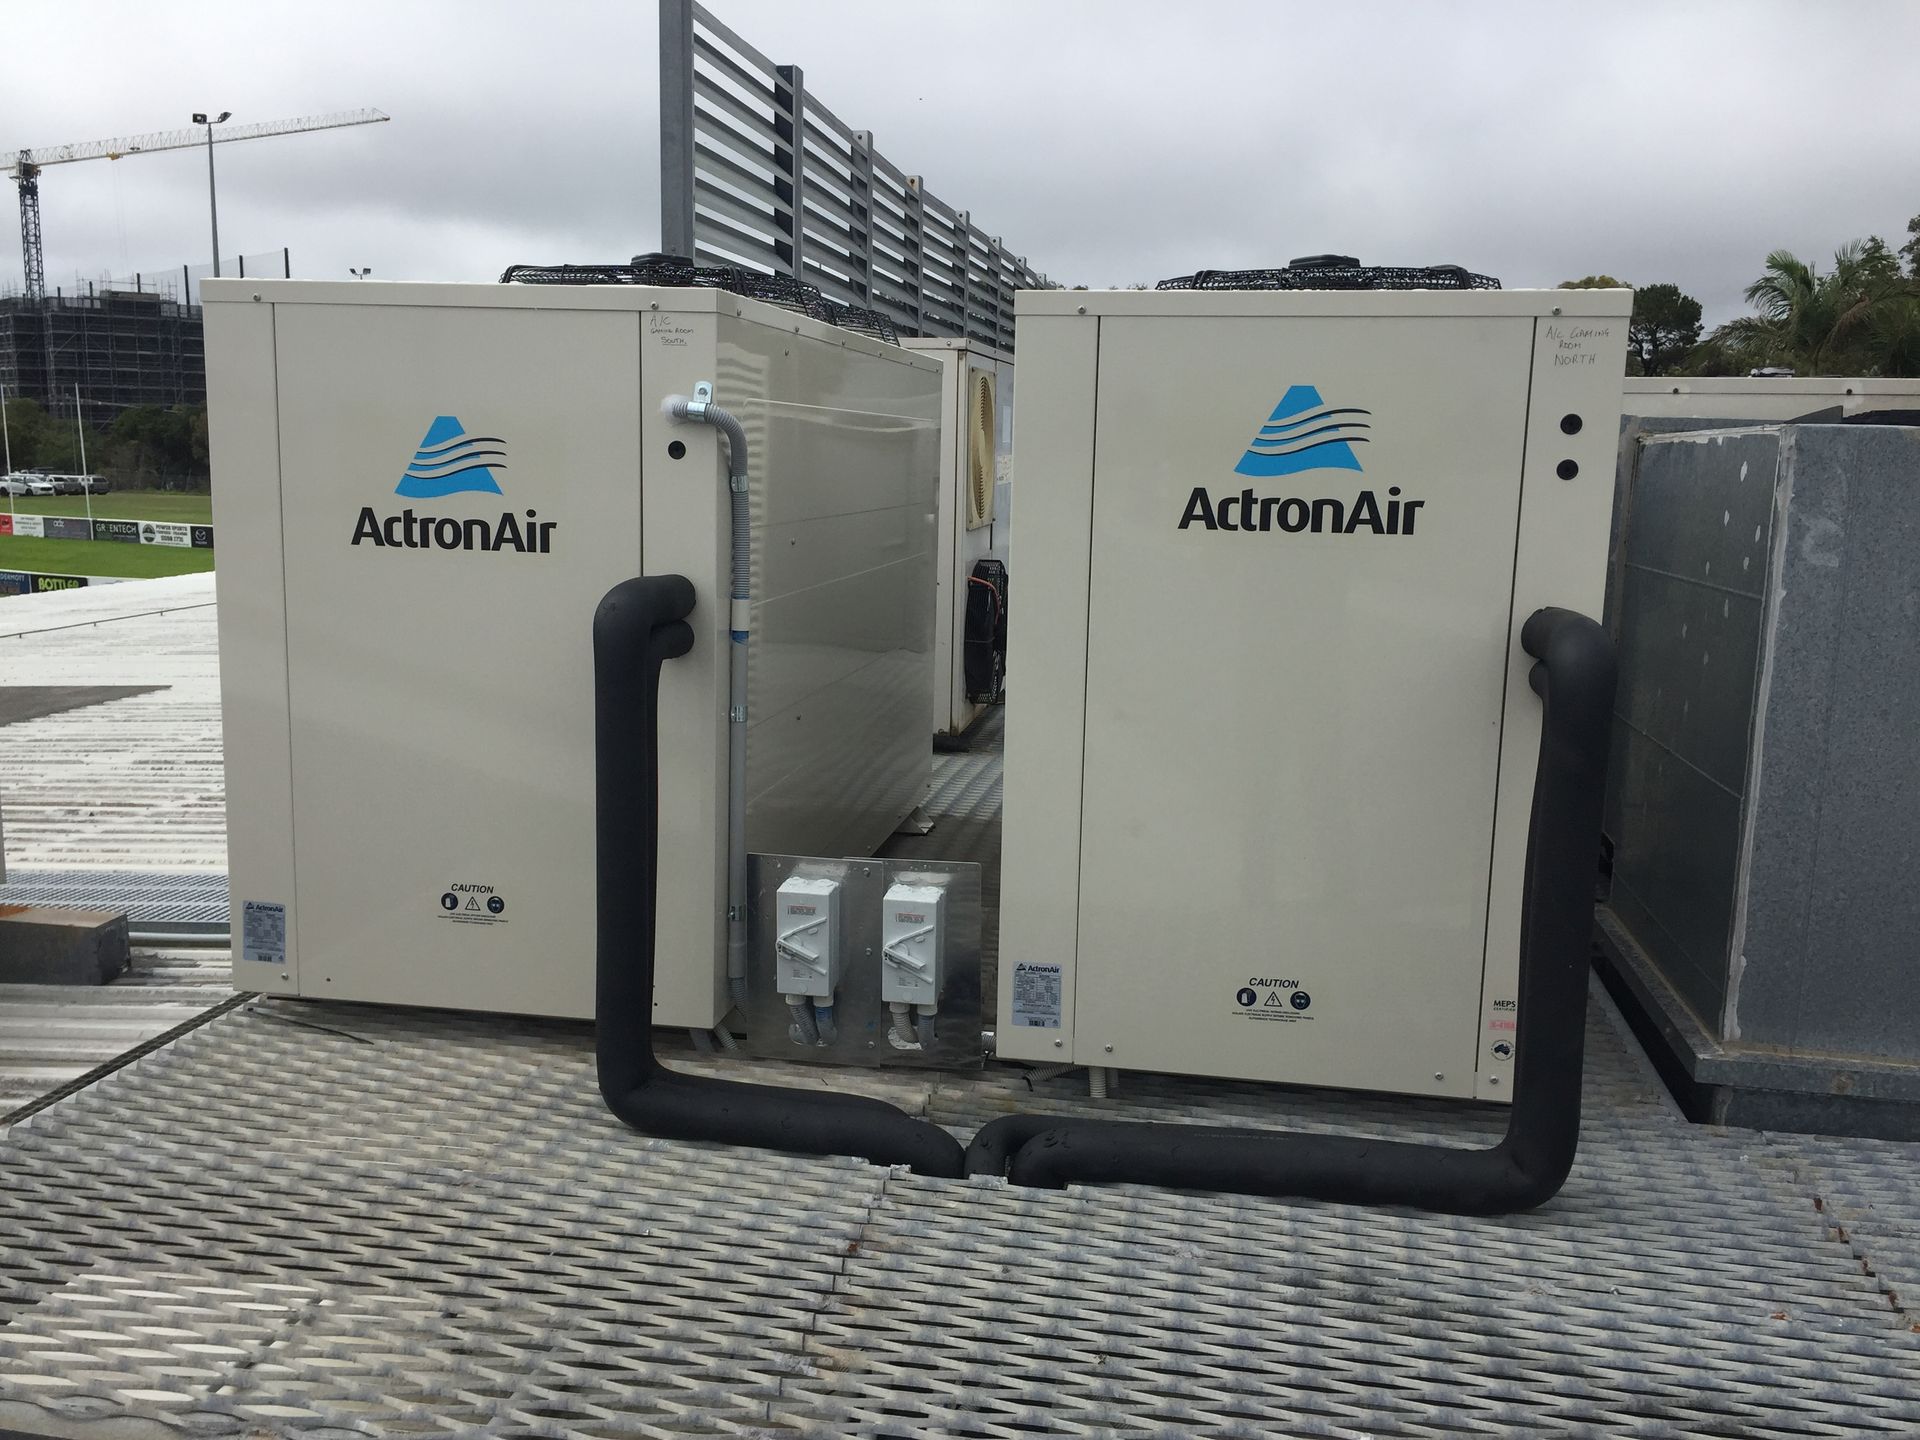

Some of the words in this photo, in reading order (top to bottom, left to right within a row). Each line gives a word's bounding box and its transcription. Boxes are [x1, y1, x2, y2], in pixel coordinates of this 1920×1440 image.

[649, 313, 672, 327] A/C
[1559, 340, 1582, 349] ROOM
[1554, 353, 1596, 366] NORTH
[1177, 486, 1426, 535] ActronAir
[351, 507, 558, 554] ActronAir
[451, 883, 494, 894] CAUTION
[255, 904, 284, 913] ActronAir
[1028, 965, 1060, 974] ActronAir
[1249, 977, 1300, 989] CAUTION
[1493, 999, 1517, 1008] MEPS
